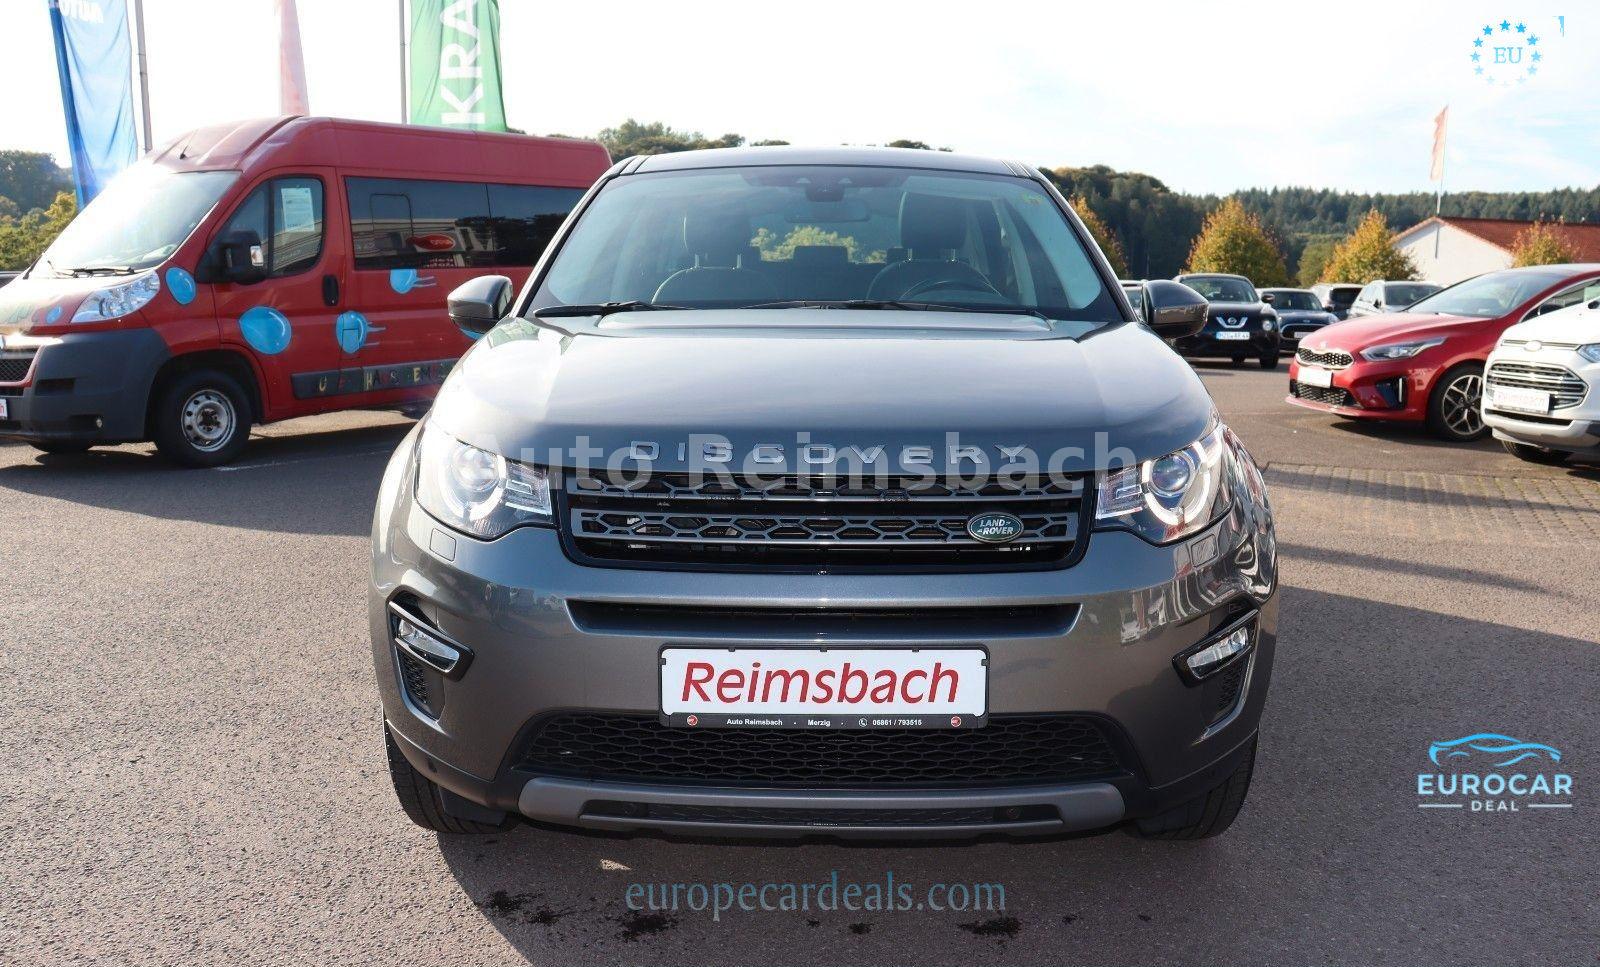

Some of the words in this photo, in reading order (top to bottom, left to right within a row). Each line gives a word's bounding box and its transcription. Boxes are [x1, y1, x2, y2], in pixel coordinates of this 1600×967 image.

[629, 441, 1028, 464] DISCOVERY
[980, 519, 1006, 527] LAND
[982, 527, 1014, 535] ROVER
[681, 662, 959, 703] Reimsbach
[726, 718, 743, 726] Auto
[744, 718, 783, 726] Reimsbach
[807, 719, 831, 728] Merzig
